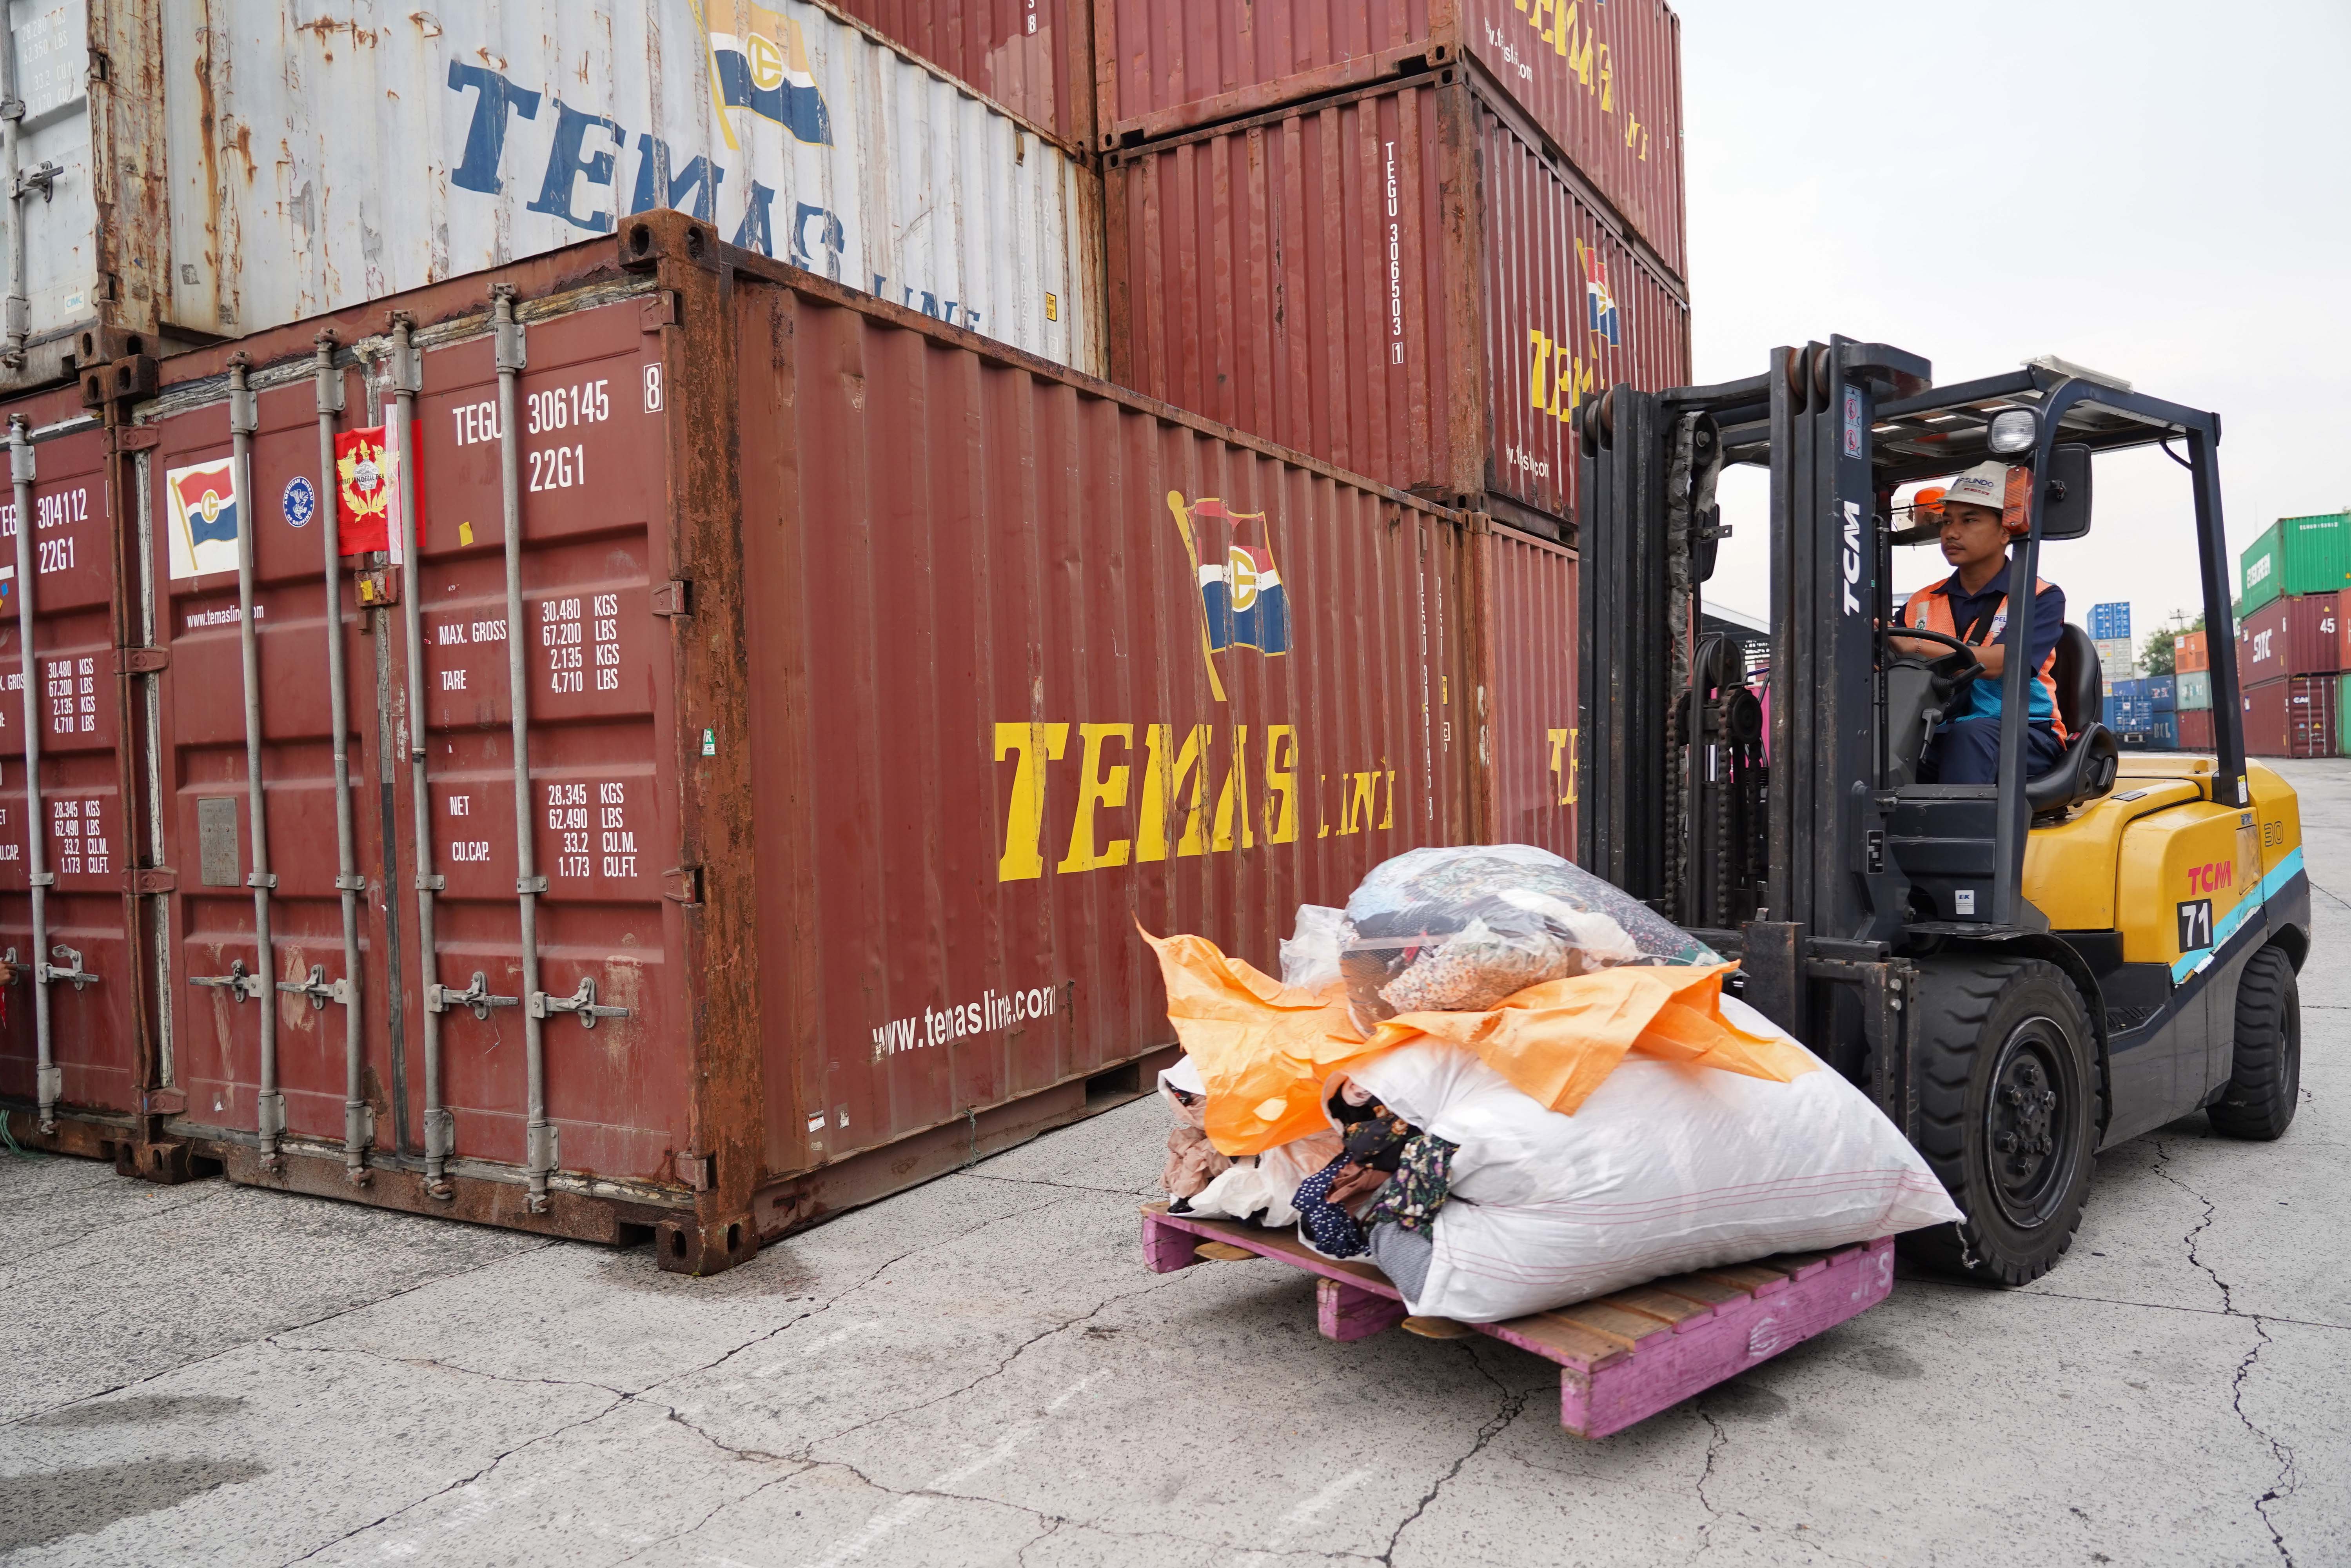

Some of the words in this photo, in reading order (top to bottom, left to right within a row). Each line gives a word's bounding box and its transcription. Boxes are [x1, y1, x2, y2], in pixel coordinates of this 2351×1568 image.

[1029, 15, 1035, 32] 8
[24, 39, 48, 64] 62.350
[54, 30, 68, 50] LBS
[1385, 142, 1398, 217] TEGU
[1390, 223, 1401, 336] 306503
[66, 295, 82, 308] CIMC
[1395, 344, 1401, 362] 1
[1530, 329, 1605, 423] TEM
[452, 401, 502, 446] TEGU
[528, 379, 610, 435] 306145
[647, 367, 660, 409] 8
[530, 444, 584, 492] 22G1
[284, 478, 301, 505] AMERICAN
[301, 479, 314, 501] BUREAU
[1959, 477, 1994, 487] PELINDO
[38, 488, 88, 529] 304112
[292, 510, 311, 526] SHIPPING
[40, 536, 74, 574] 22G1
[1843, 500, 1860, 617] TCM
[2247, 553, 2271, 590] EVERGREEN
[542, 598, 581, 621] 30,480
[594, 594, 617, 616] KGS
[439, 624, 467, 645] MAX.
[472, 620, 506, 643] GROSS
[543, 623, 582, 646] 67,200
[595, 620, 617, 641] LBS
[2320, 617, 2335, 634] 45
[550, 647, 582, 670] 2,135
[596, 644, 619, 666] KGS
[2253, 628, 2273, 663] SITC
[48, 660, 72, 679] 30,480
[79, 658, 94, 675] KGS
[441, 670, 467, 691] TARE
[551, 671, 583, 693] 4,710
[597, 669, 618, 691] LBS
[8, 673, 24, 690] GROS
[49, 679, 73, 697] 67,200
[80, 677, 93, 694] LBS
[53, 698, 73, 715] 2,135
[81, 696, 95, 713] KGS
[54, 716, 74, 734] 4,710
[82, 715, 95, 732] LBS
[706, 730, 712, 742] R
[54, 801, 78, 818] 28,345
[85, 800, 100, 817] KGS
[450, 795, 470, 816] NET
[548, 784, 586, 806] 28,345
[600, 783, 624, 804] KGS
[995, 722, 1299, 882] TEMAS
[55, 820, 79, 837] 62,490
[86, 819, 100, 836] LBS
[549, 808, 588, 830] 62,490
[601, 807, 623, 828] LBS
[452, 841, 490, 862] CU.CAP.
[564, 832, 589, 853] 33.2
[603, 831, 637, 853] CU.M.
[2264, 820, 2284, 847] 30
[0, 844, 19, 860] U.CAP.
[64, 838, 80, 855] 33.2
[87, 838, 109, 855] CU.M.
[62, 857, 80, 873] 1,173
[88, 857, 109, 874] CU.FT.
[559, 856, 590, 877] 1,173
[603, 856, 638, 877] CU.FT.
[2188, 860, 2232, 896] TCM
[2182, 902, 2210, 947] 71
